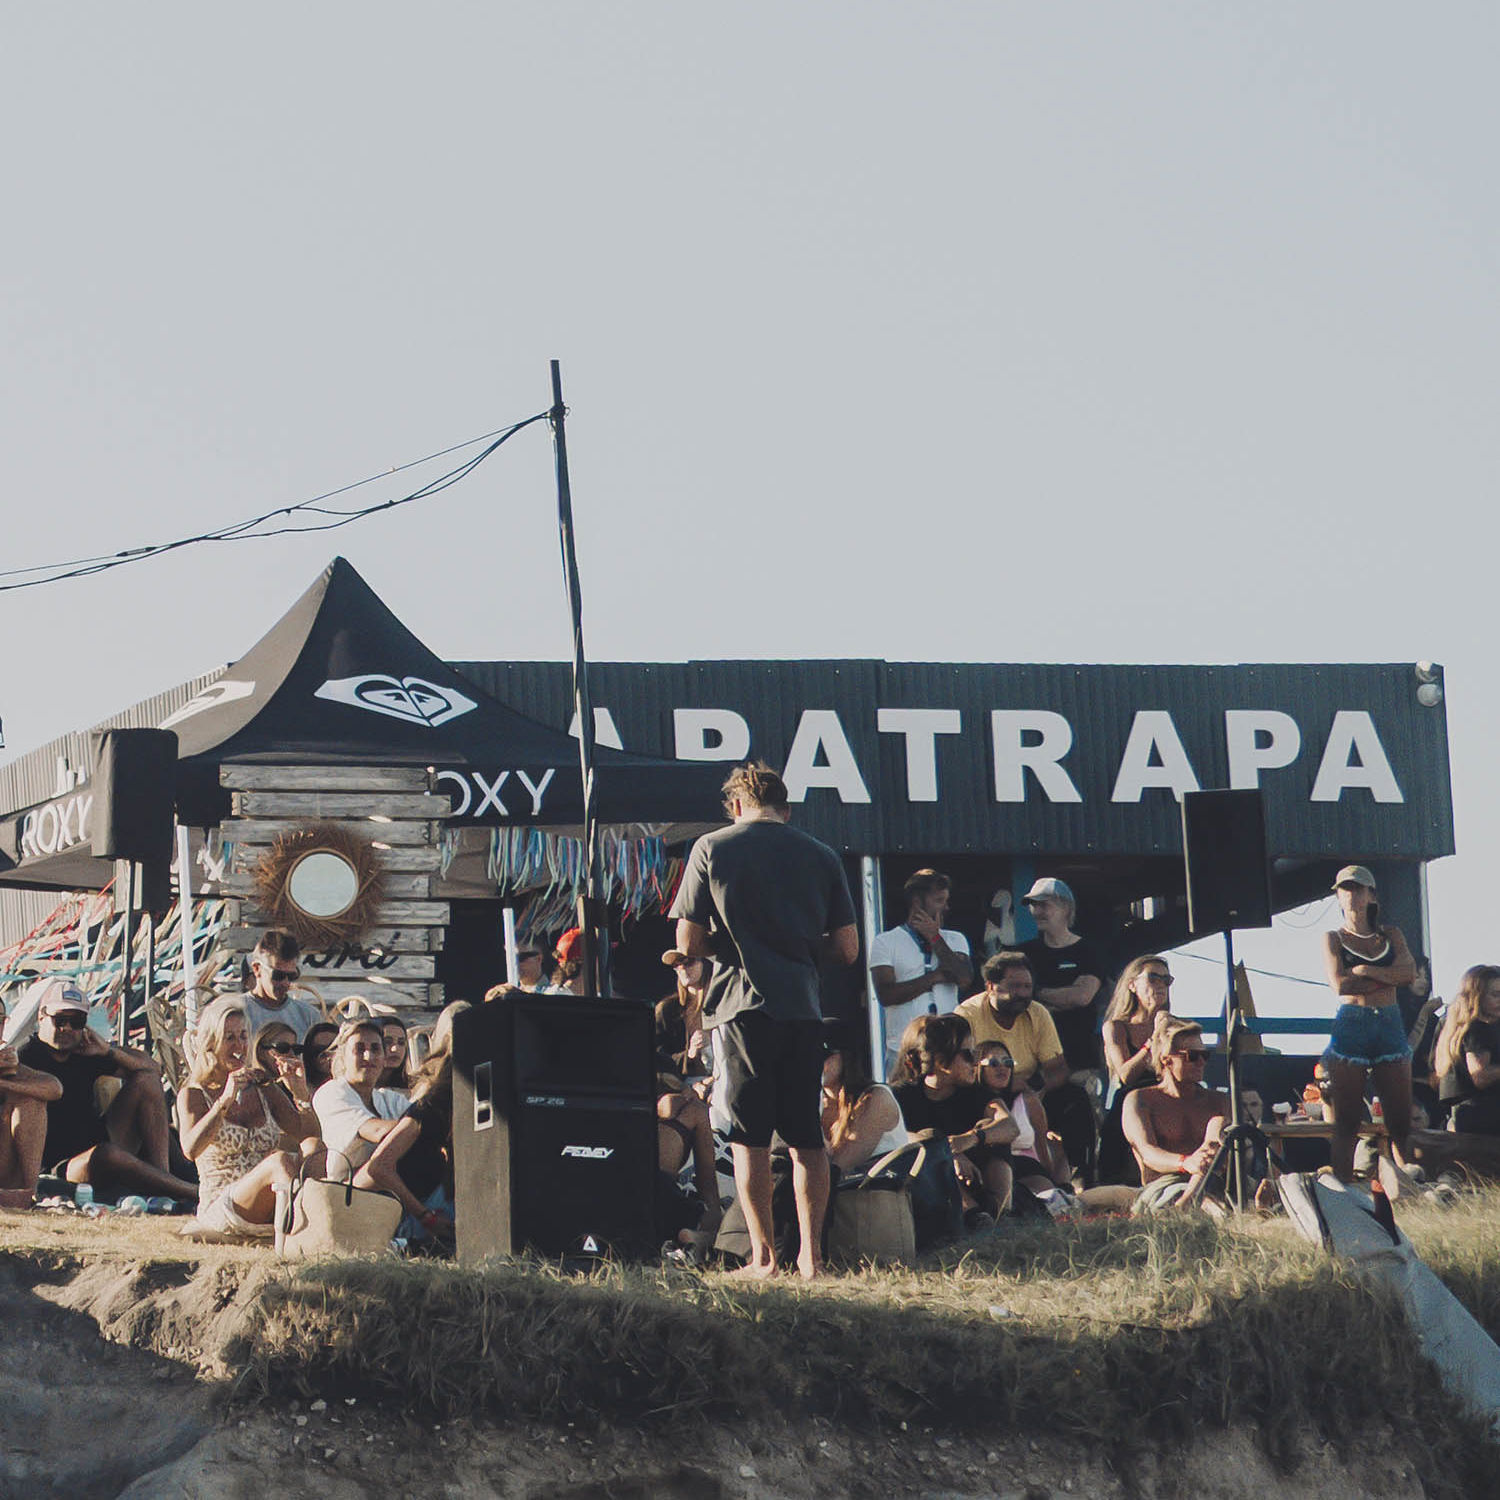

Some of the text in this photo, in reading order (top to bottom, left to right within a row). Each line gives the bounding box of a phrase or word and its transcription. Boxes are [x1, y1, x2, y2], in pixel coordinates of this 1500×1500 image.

[434, 768, 556, 817] OXY
[22, 795, 93, 858] ROXY
[302, 931, 402, 970] ord
[561, 1146, 614, 1158] PEAVEY
